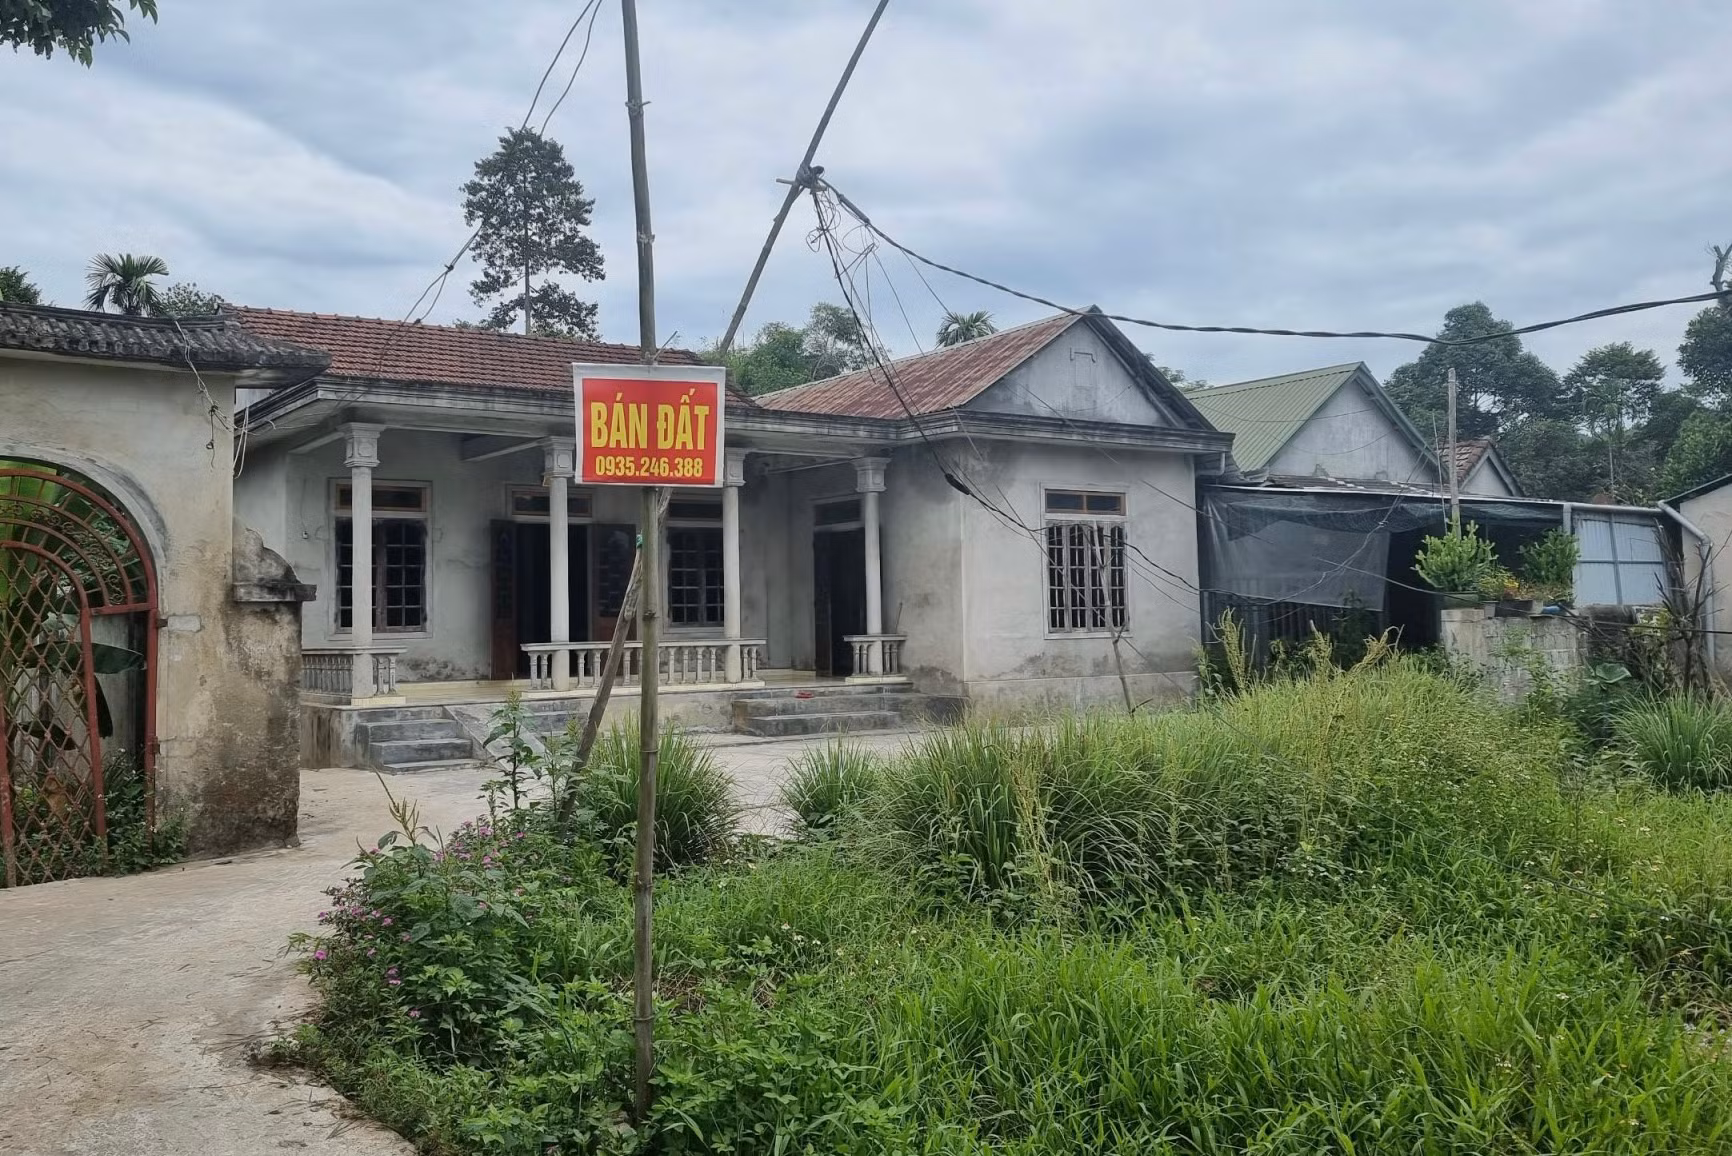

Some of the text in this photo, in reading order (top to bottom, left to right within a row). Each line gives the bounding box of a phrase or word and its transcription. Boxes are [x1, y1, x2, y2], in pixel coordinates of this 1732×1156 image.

[590, 388, 710, 450] BÁN ĐẤT
[595, 455, 703, 478] 0935.246.388
